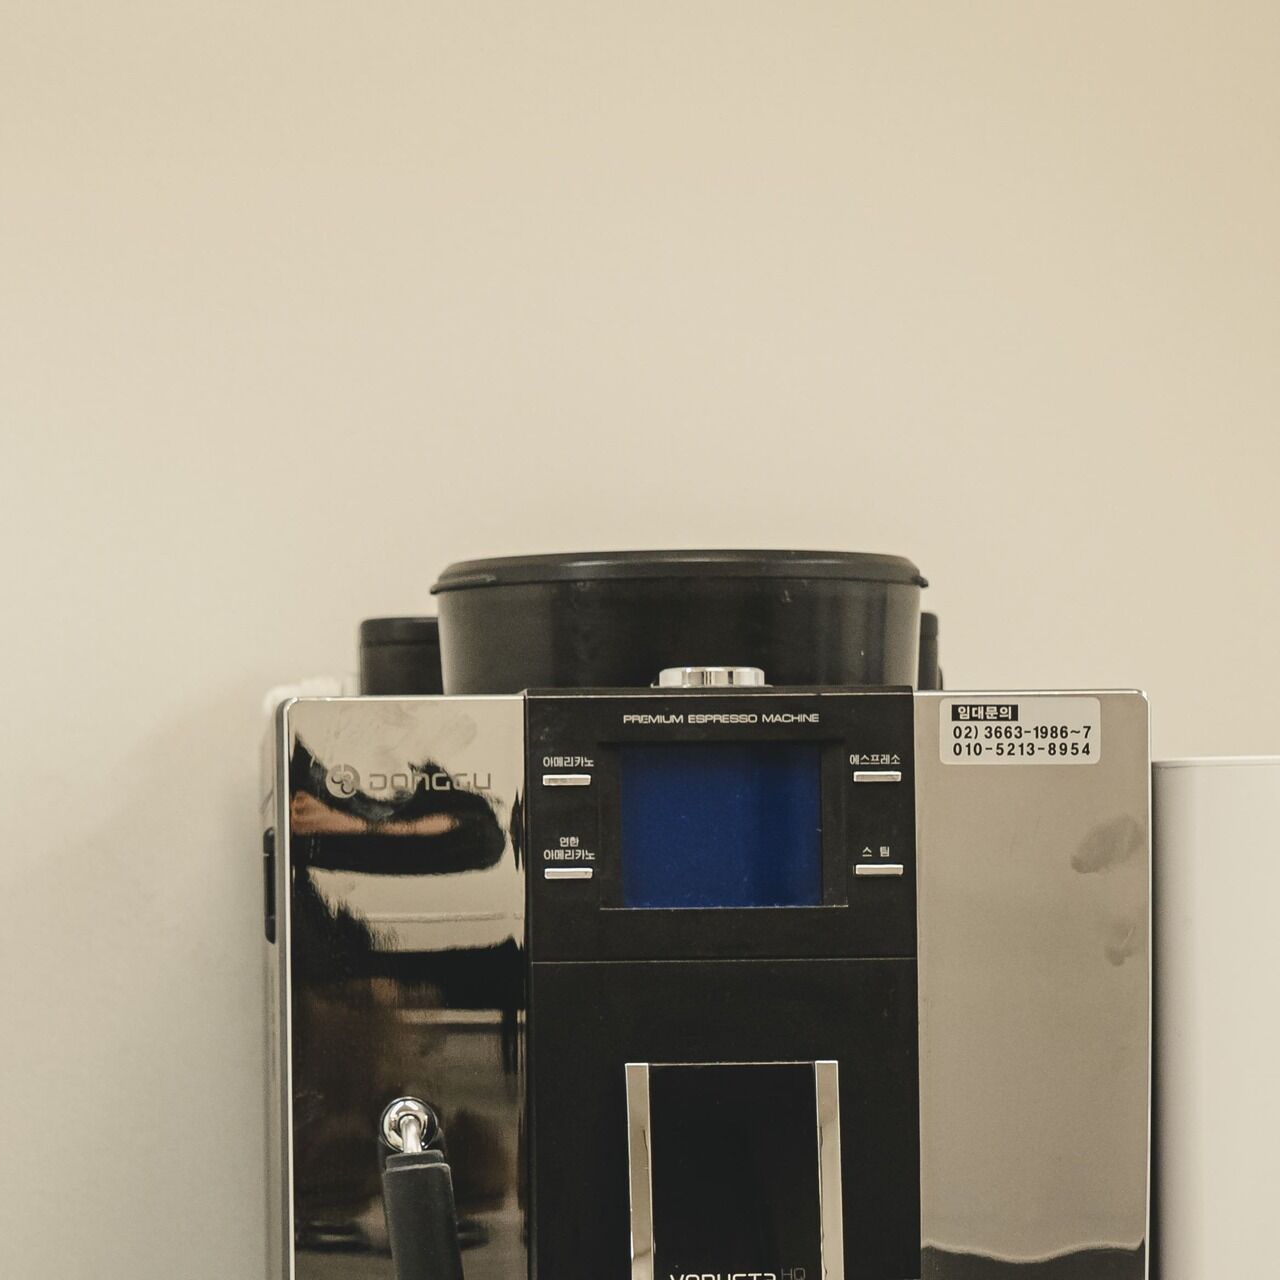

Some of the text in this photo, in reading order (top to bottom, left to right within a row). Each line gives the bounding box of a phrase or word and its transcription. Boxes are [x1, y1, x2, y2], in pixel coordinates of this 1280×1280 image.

[623, 712, 819, 724] PREMIUM ESPRESSO MACHINE
[957, 705, 1012, 720] 임대문의
[953, 725, 1091, 740] 02) 3663-1986~7
[952, 742, 1091, 756] 010-5213-8954
[543, 756, 594, 767] 아메리카노
[849, 754, 901, 765] 에스프레소
[559, 836, 579, 848] 연한
[543, 849, 595, 861] 아메리카노
